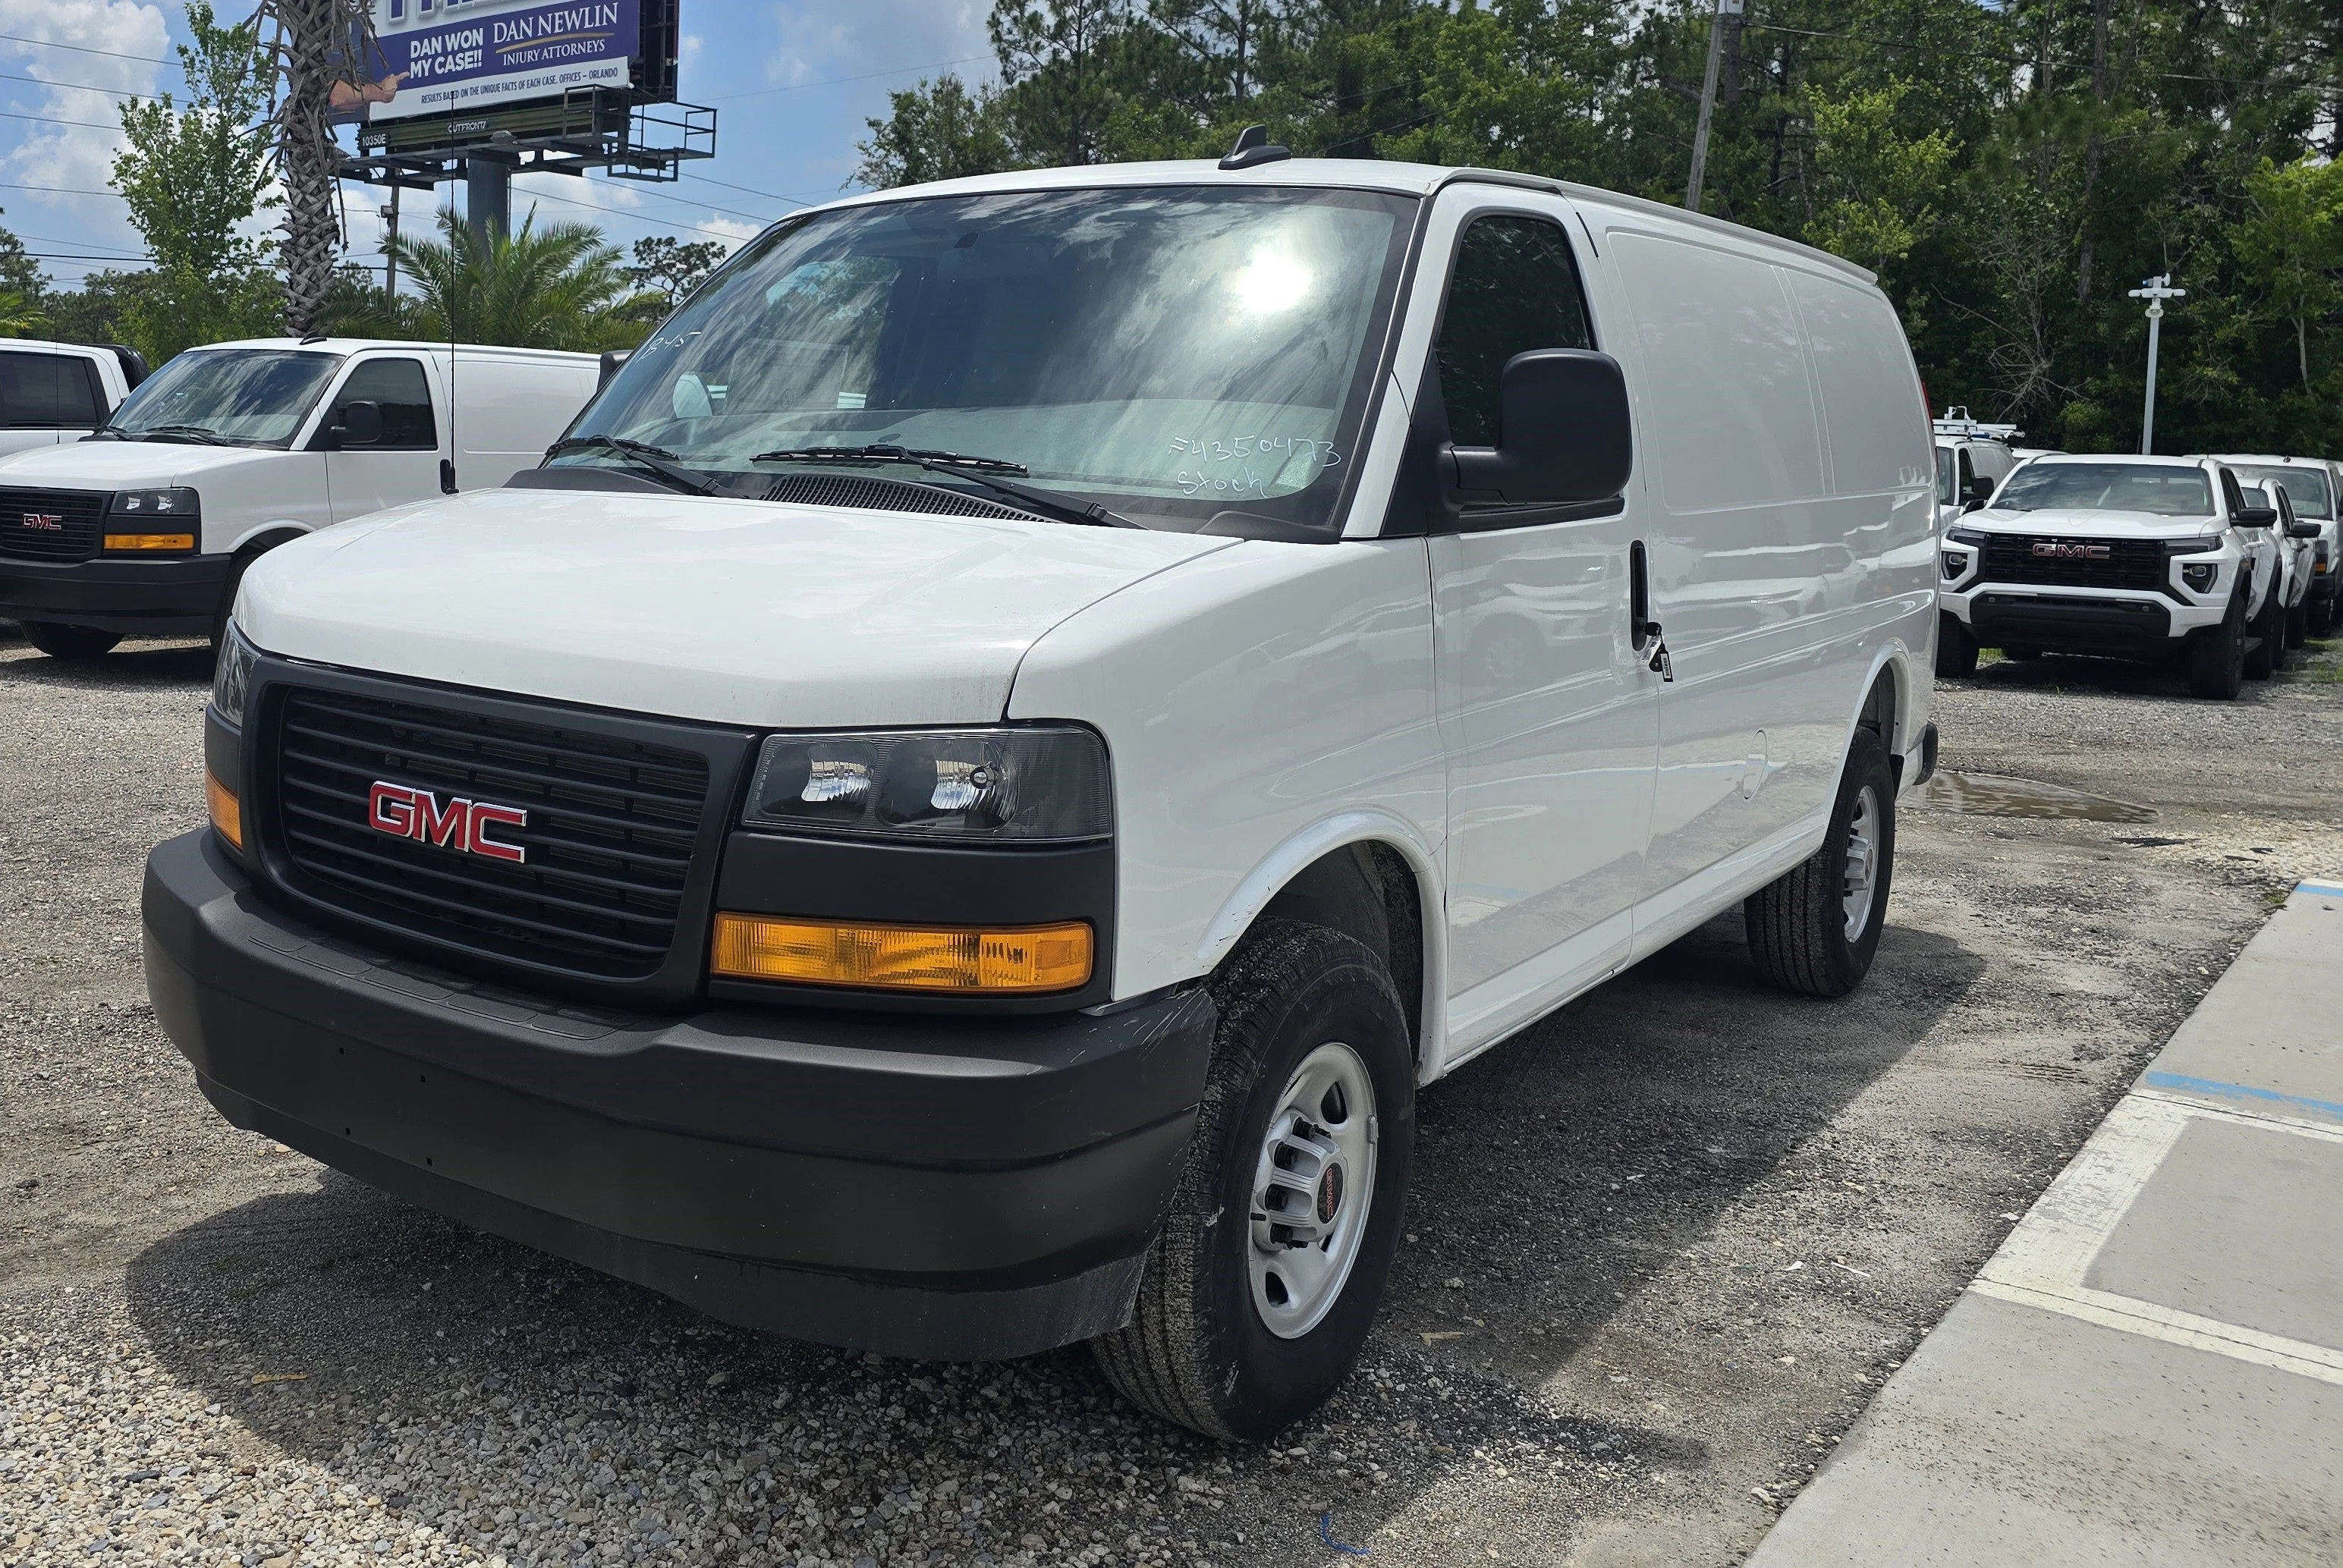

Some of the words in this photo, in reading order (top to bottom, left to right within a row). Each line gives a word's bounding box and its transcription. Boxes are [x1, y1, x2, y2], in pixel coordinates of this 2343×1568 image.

[493, 17, 533, 43] DAN
[537, 2, 618, 36] NEWLIN
[410, 36, 442, 58] DAN
[445, 27, 483, 52] WON
[503, 49, 540, 66] INJURY
[541, 39, 605, 61] ATTORNEYS
[410, 58, 432, 79] MY
[435, 49, 483, 74] CASE!!
[421, 93, 442, 104] RESULTS
[461, 88, 469, 98] ON
[470, 86, 480, 96] THE
[480, 83, 501, 95] UNIQUE
[502, 81, 517, 92] FACTS
[518, 80, 526, 90] OF
[527, 77, 541, 88] EACH
[558, 71, 581, 83] OFFICES
[588, 67, 618, 80] ORLANDO
[361, 133, 387, 147] 10350E
[22, 513, 62, 530] GMC
[2032, 542, 2110, 560] GMC
[368, 780, 527, 864] GMC
